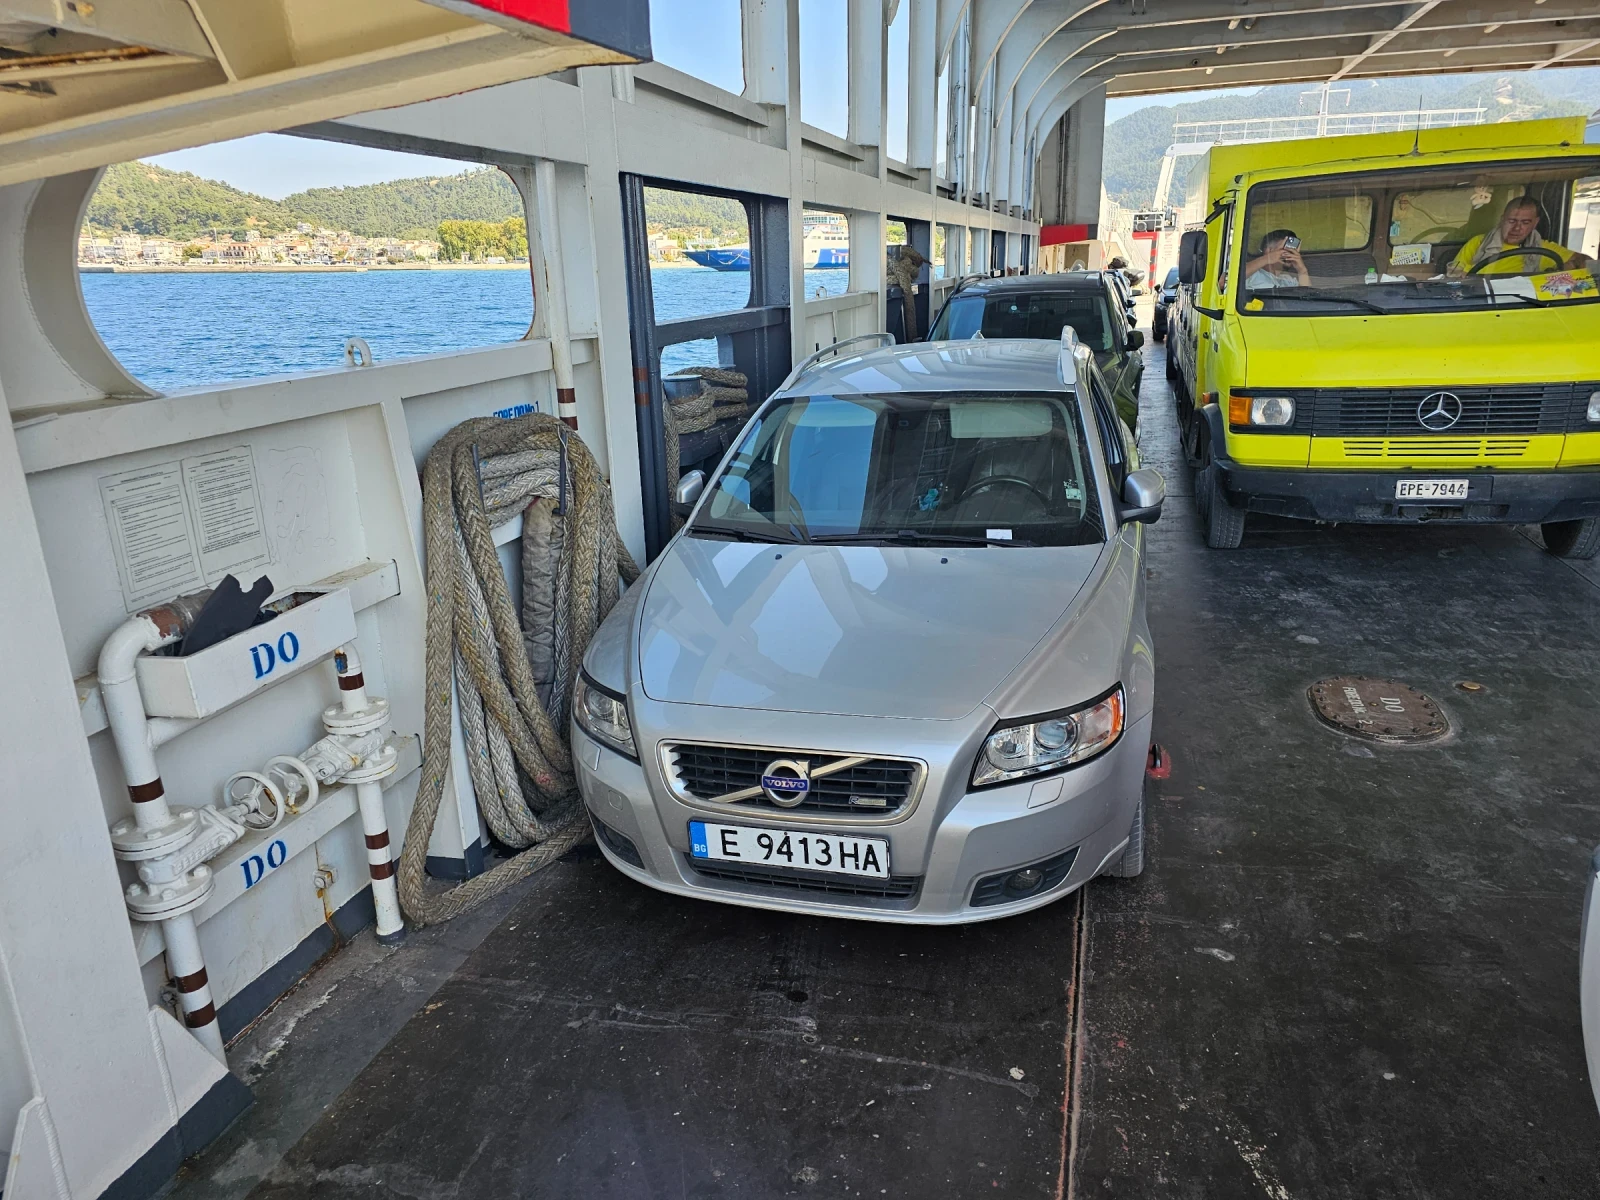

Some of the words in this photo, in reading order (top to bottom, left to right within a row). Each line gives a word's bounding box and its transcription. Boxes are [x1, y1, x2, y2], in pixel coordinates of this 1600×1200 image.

[1399, 483, 1466, 496] EPE-7944
[249, 631, 300, 680] DO
[1379, 697, 1405, 712] DO
[764, 778, 806, 789] VOLVO
[693, 843, 707, 853] BG
[240, 839, 287, 889] DO
